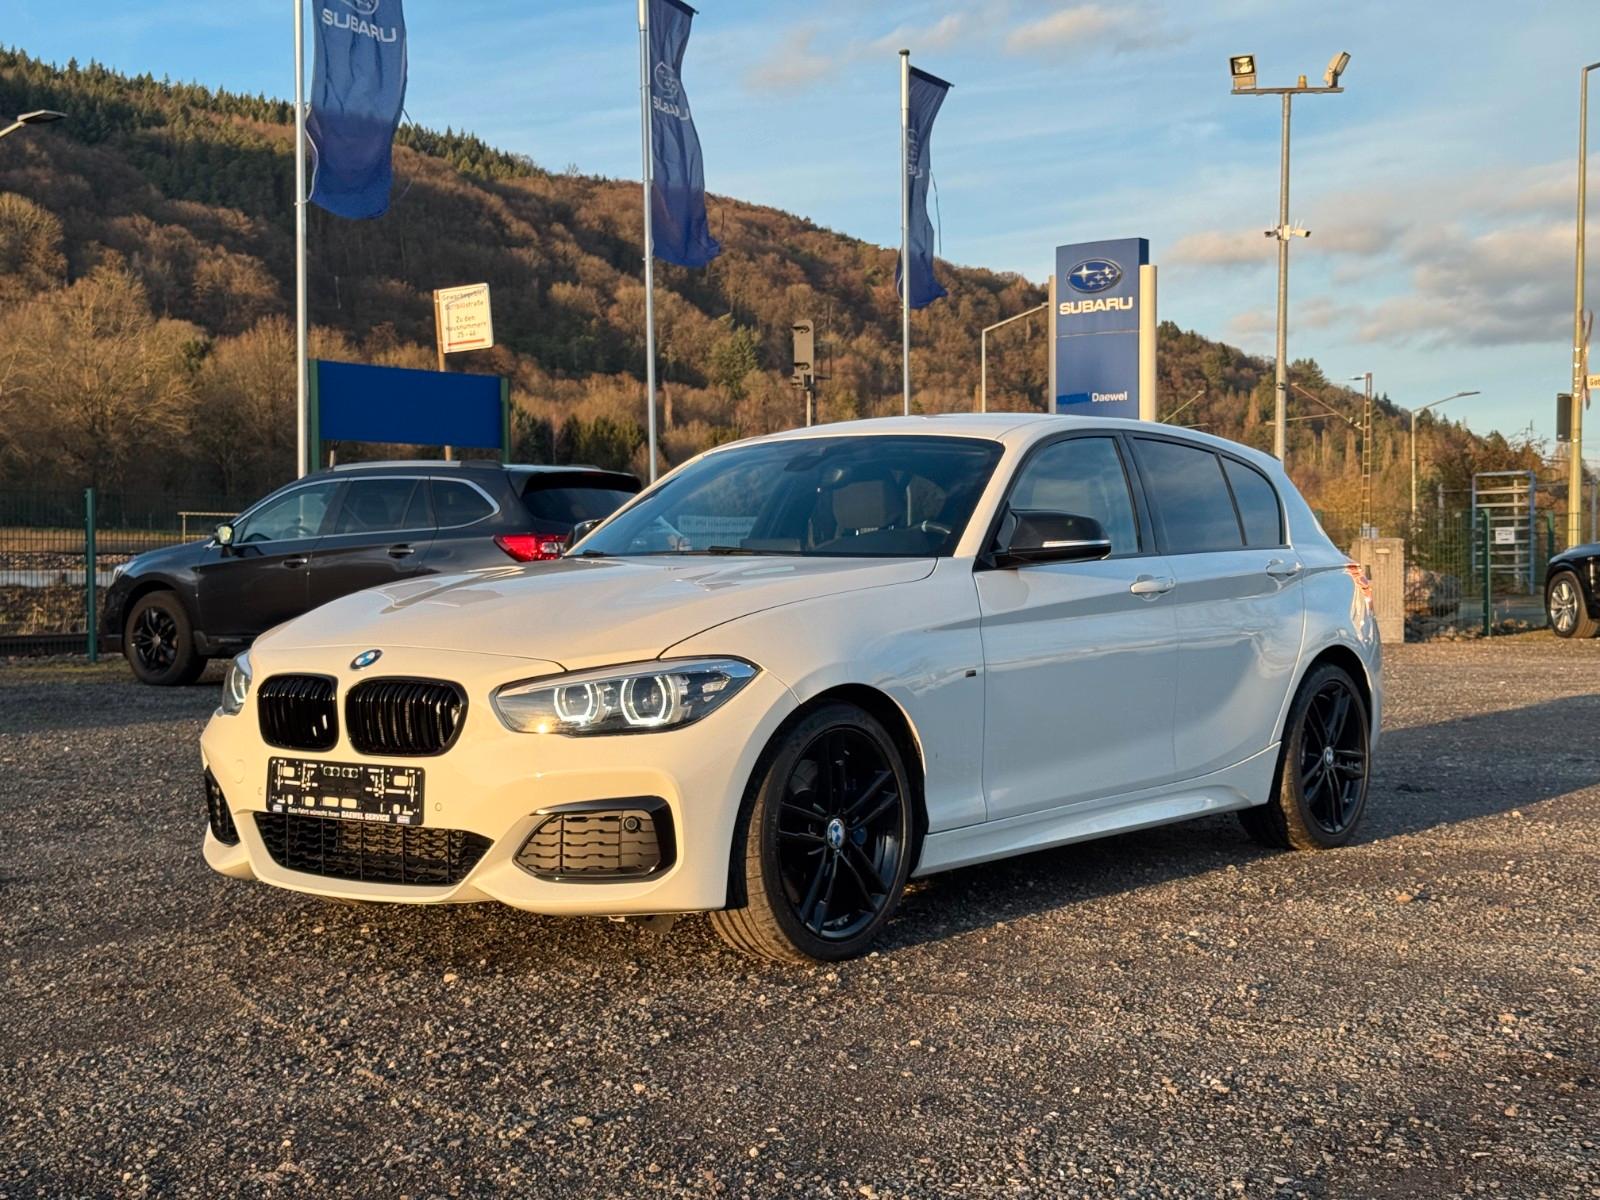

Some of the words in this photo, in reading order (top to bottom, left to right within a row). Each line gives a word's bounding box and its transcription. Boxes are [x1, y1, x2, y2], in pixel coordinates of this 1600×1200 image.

[321, 8, 397, 42] SUBARU
[1059, 296, 1134, 315] SUBARU
[1091, 391, 1128, 402] Daewel
[341, 811, 364, 820] DAEWEL
[364, 813, 390, 822] SERVICE
